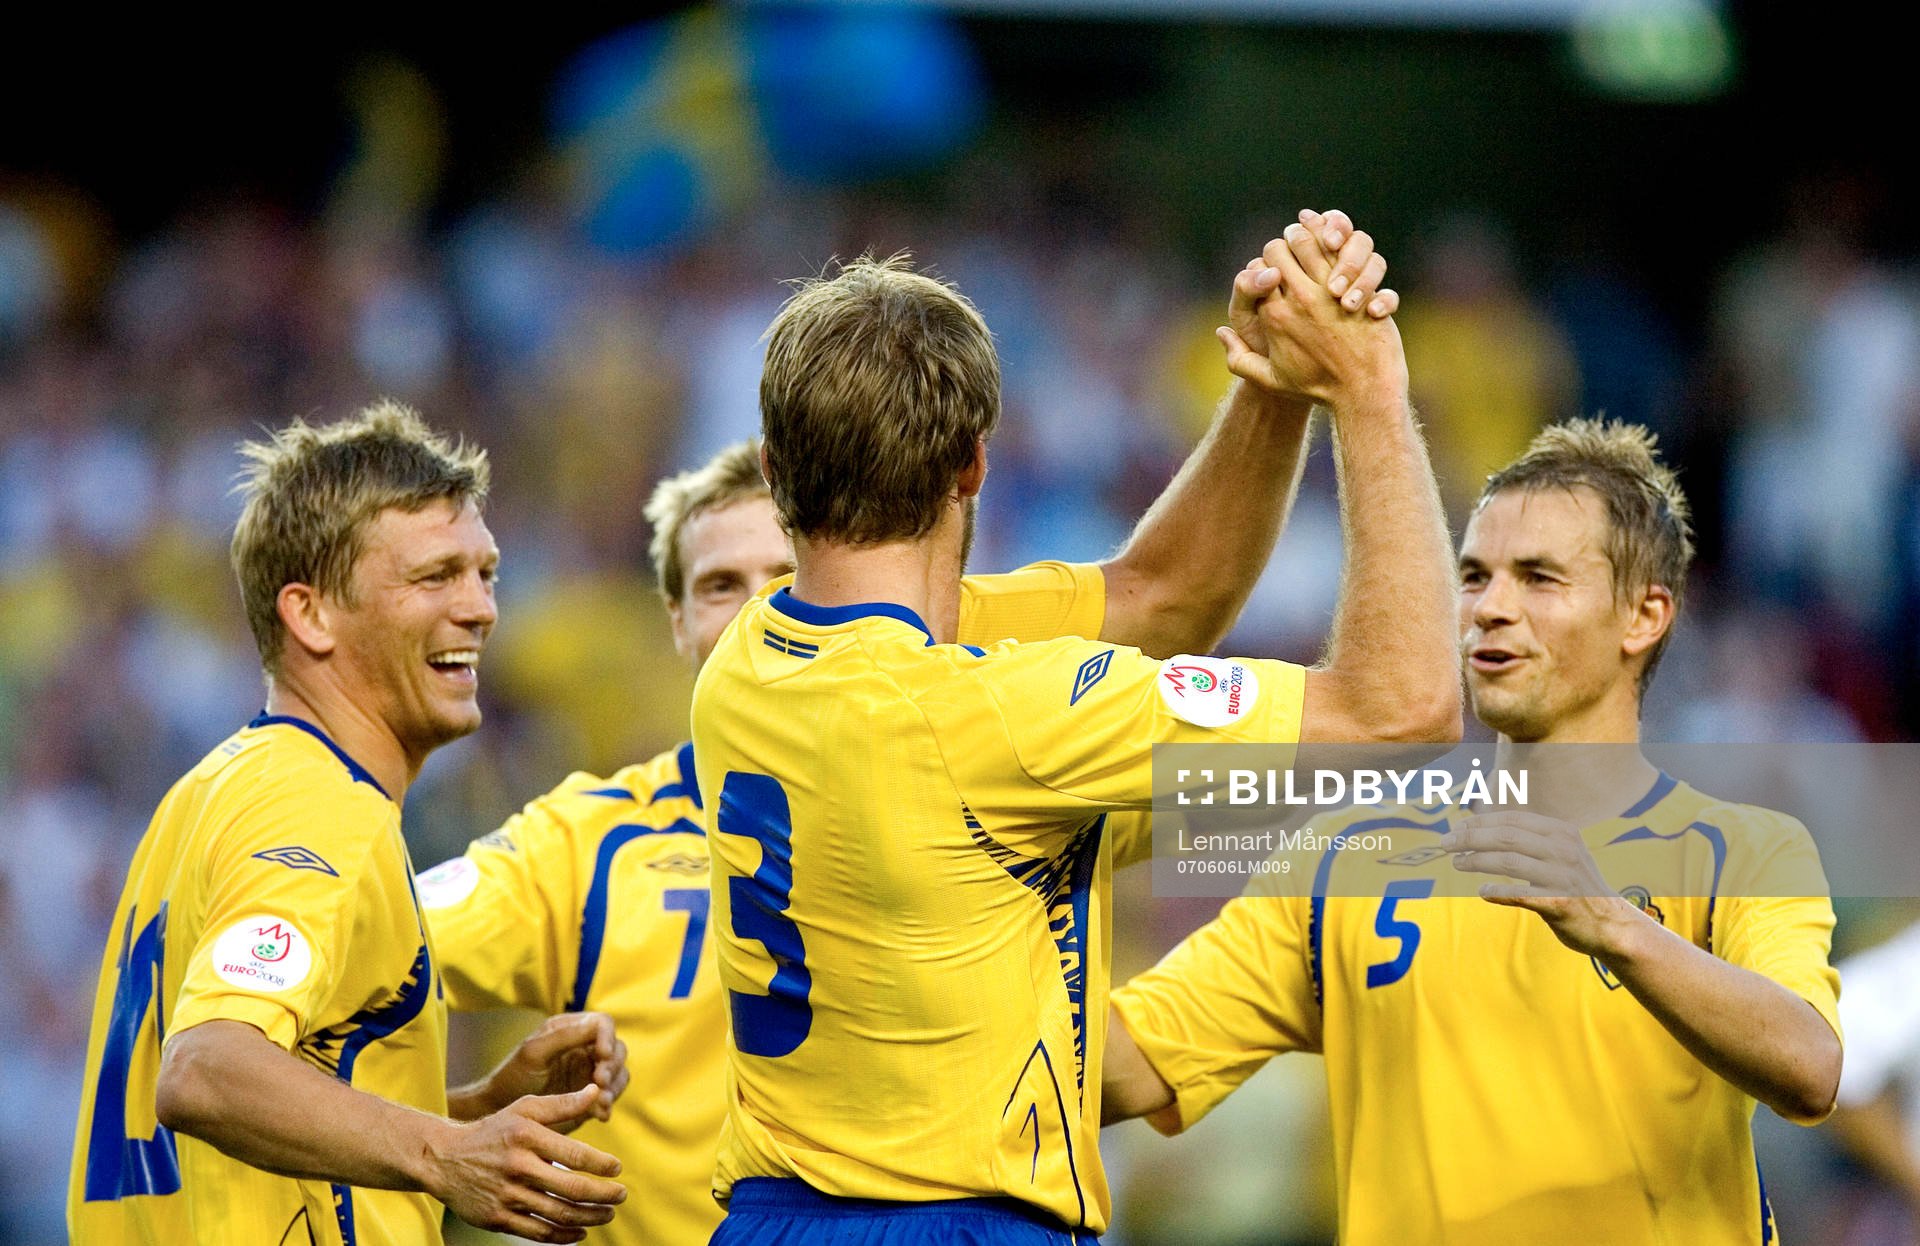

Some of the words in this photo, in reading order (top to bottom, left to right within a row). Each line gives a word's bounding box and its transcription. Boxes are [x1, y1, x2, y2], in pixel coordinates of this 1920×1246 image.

[663, 888, 711, 999] 7
[717, 770, 813, 1058] 3
[1366, 879, 1436, 989] 5
